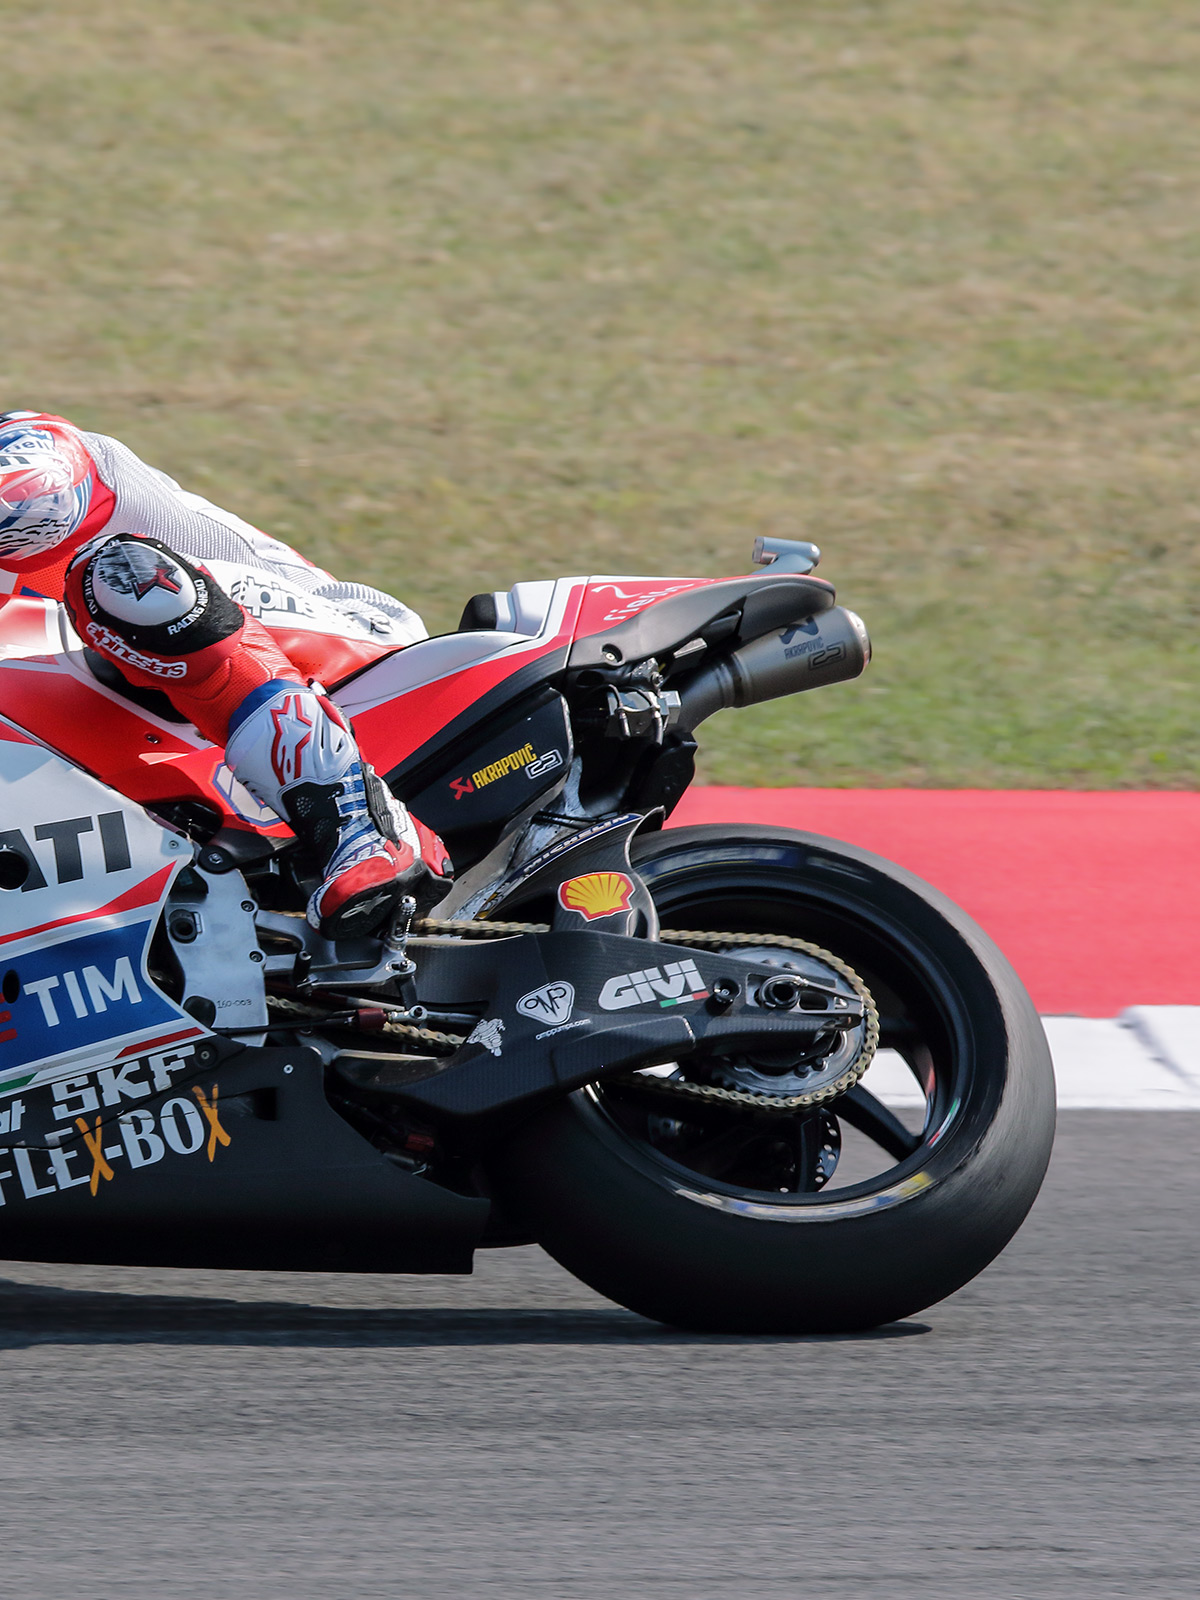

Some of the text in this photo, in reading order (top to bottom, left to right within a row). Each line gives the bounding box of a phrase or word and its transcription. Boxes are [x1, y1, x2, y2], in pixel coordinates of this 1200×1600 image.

[84, 574, 99, 615] AHEAD
[166, 578, 209, 636] RACING AHEAD
[86, 621, 188, 679] alpinestars
[523, 814, 631, 874] MICHELIN
[22, 956, 143, 1028] TIM
[598, 958, 708, 1010] GIVI
[50, 1044, 196, 1121] SKF
